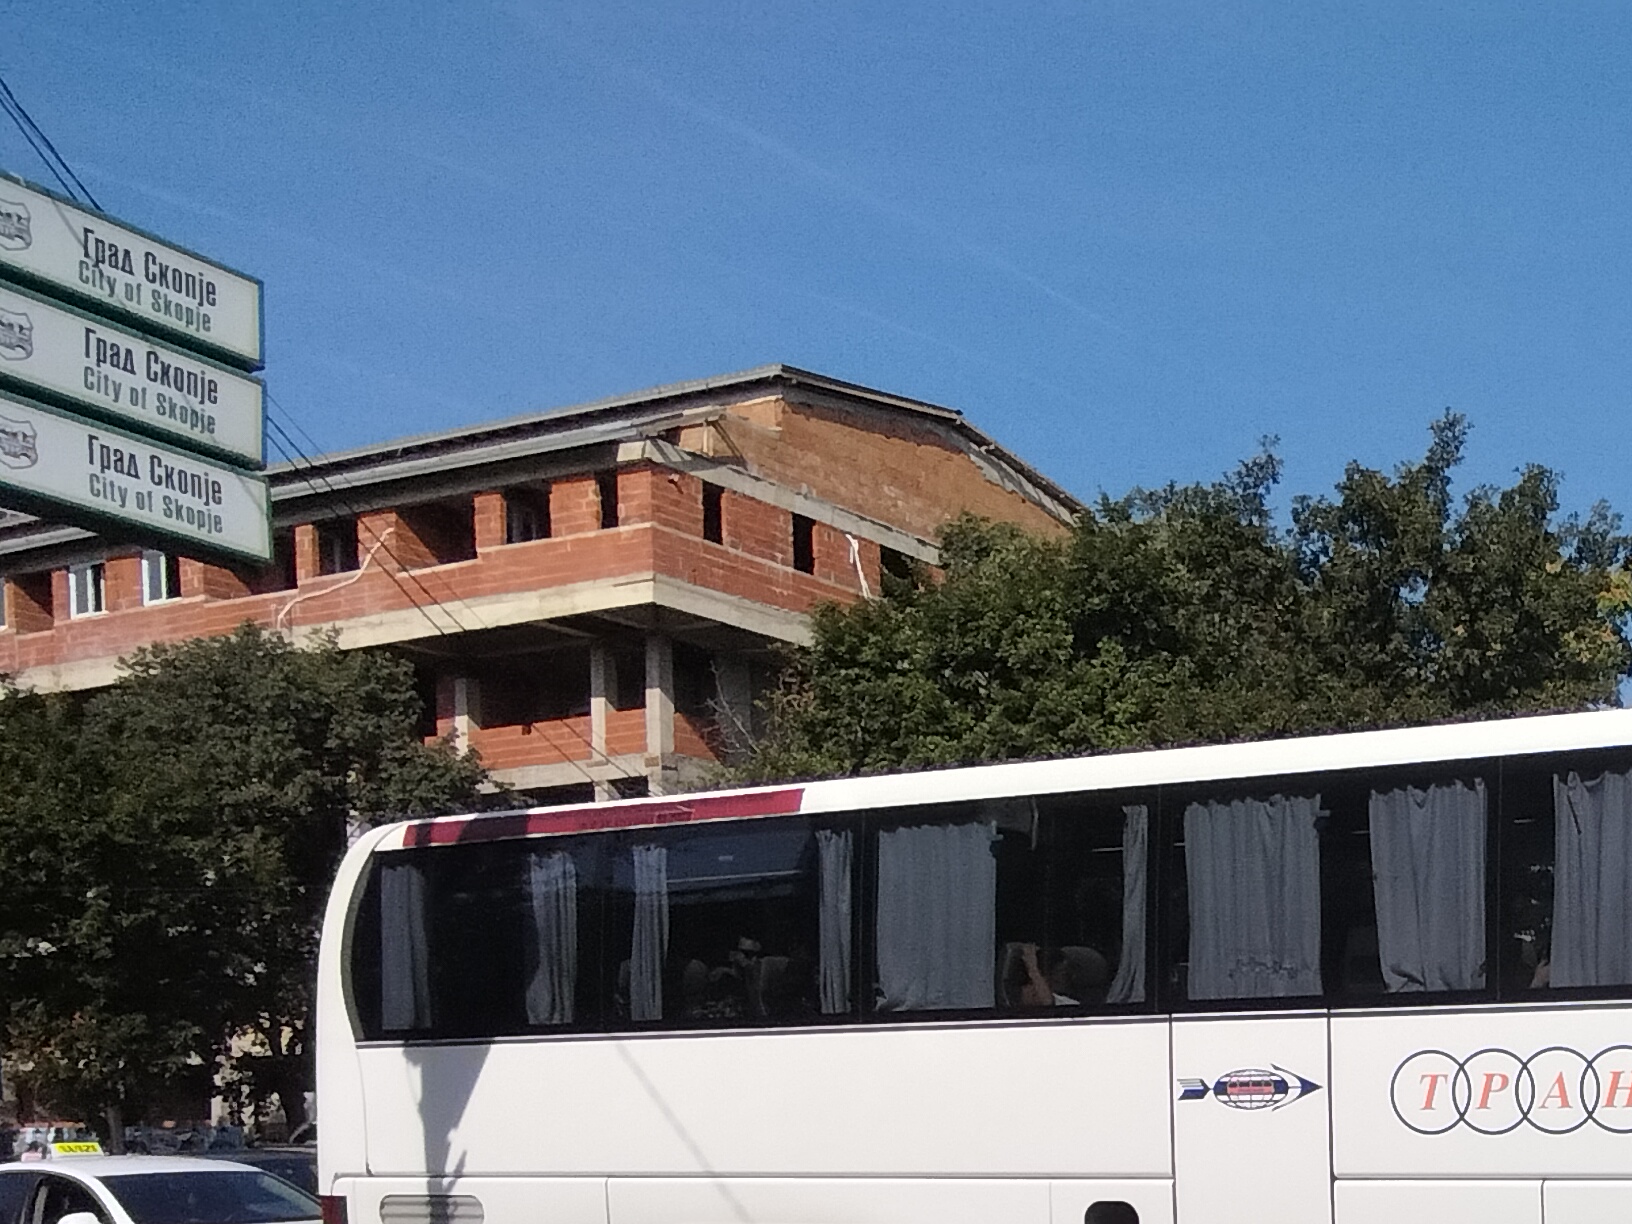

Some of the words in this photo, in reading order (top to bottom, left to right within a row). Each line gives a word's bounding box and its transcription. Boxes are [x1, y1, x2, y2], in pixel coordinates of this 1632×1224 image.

[78, 259, 117, 298] City
[124, 282, 142, 306] of
[151, 288, 211, 332] Skopje
[83, 227, 135, 276] Град
[144, 251, 217, 307] Скопје
[83, 365, 122, 403] City
[129, 386, 147, 410] of
[156, 392, 216, 435] Skopje
[84, 326, 137, 376] Град
[146, 350, 218, 405] Скопје
[87, 433, 141, 480] Град
[149, 454, 222, 507] Скопје
[89, 472, 128, 509] City
[135, 490, 153, 513] of
[162, 495, 223, 534] Skopje
